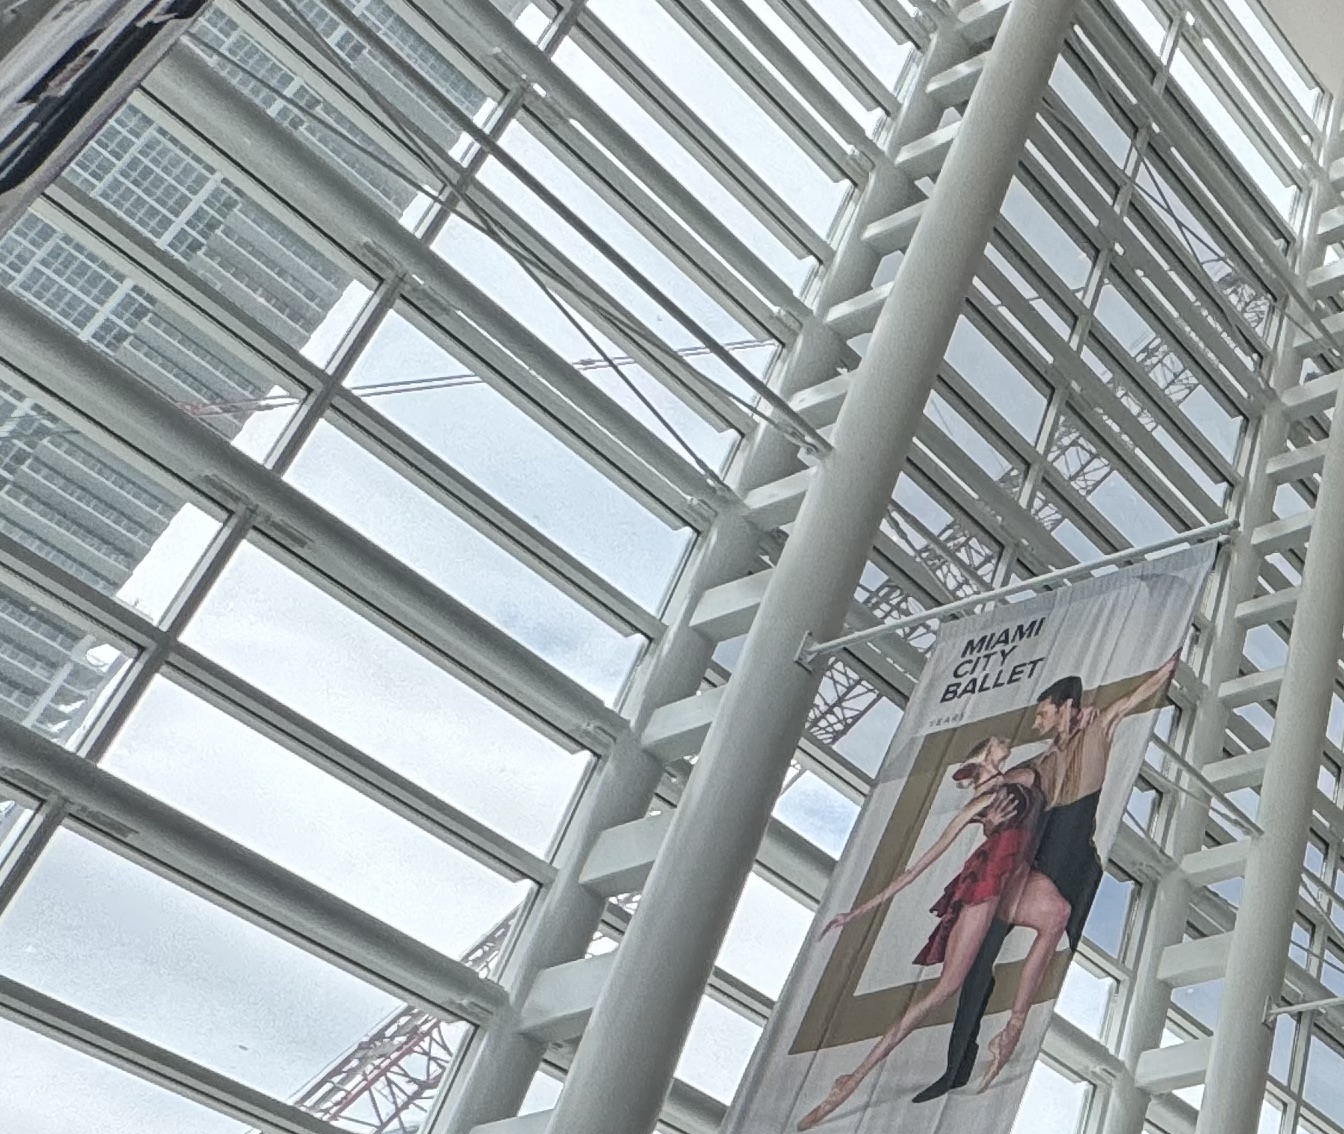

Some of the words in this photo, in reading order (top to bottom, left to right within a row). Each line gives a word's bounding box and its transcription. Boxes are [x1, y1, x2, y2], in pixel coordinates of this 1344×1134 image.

[961, 617, 1046, 658] MIAMI
[940, 657, 1045, 703] BALLET
[953, 645, 1018, 678] CITY
